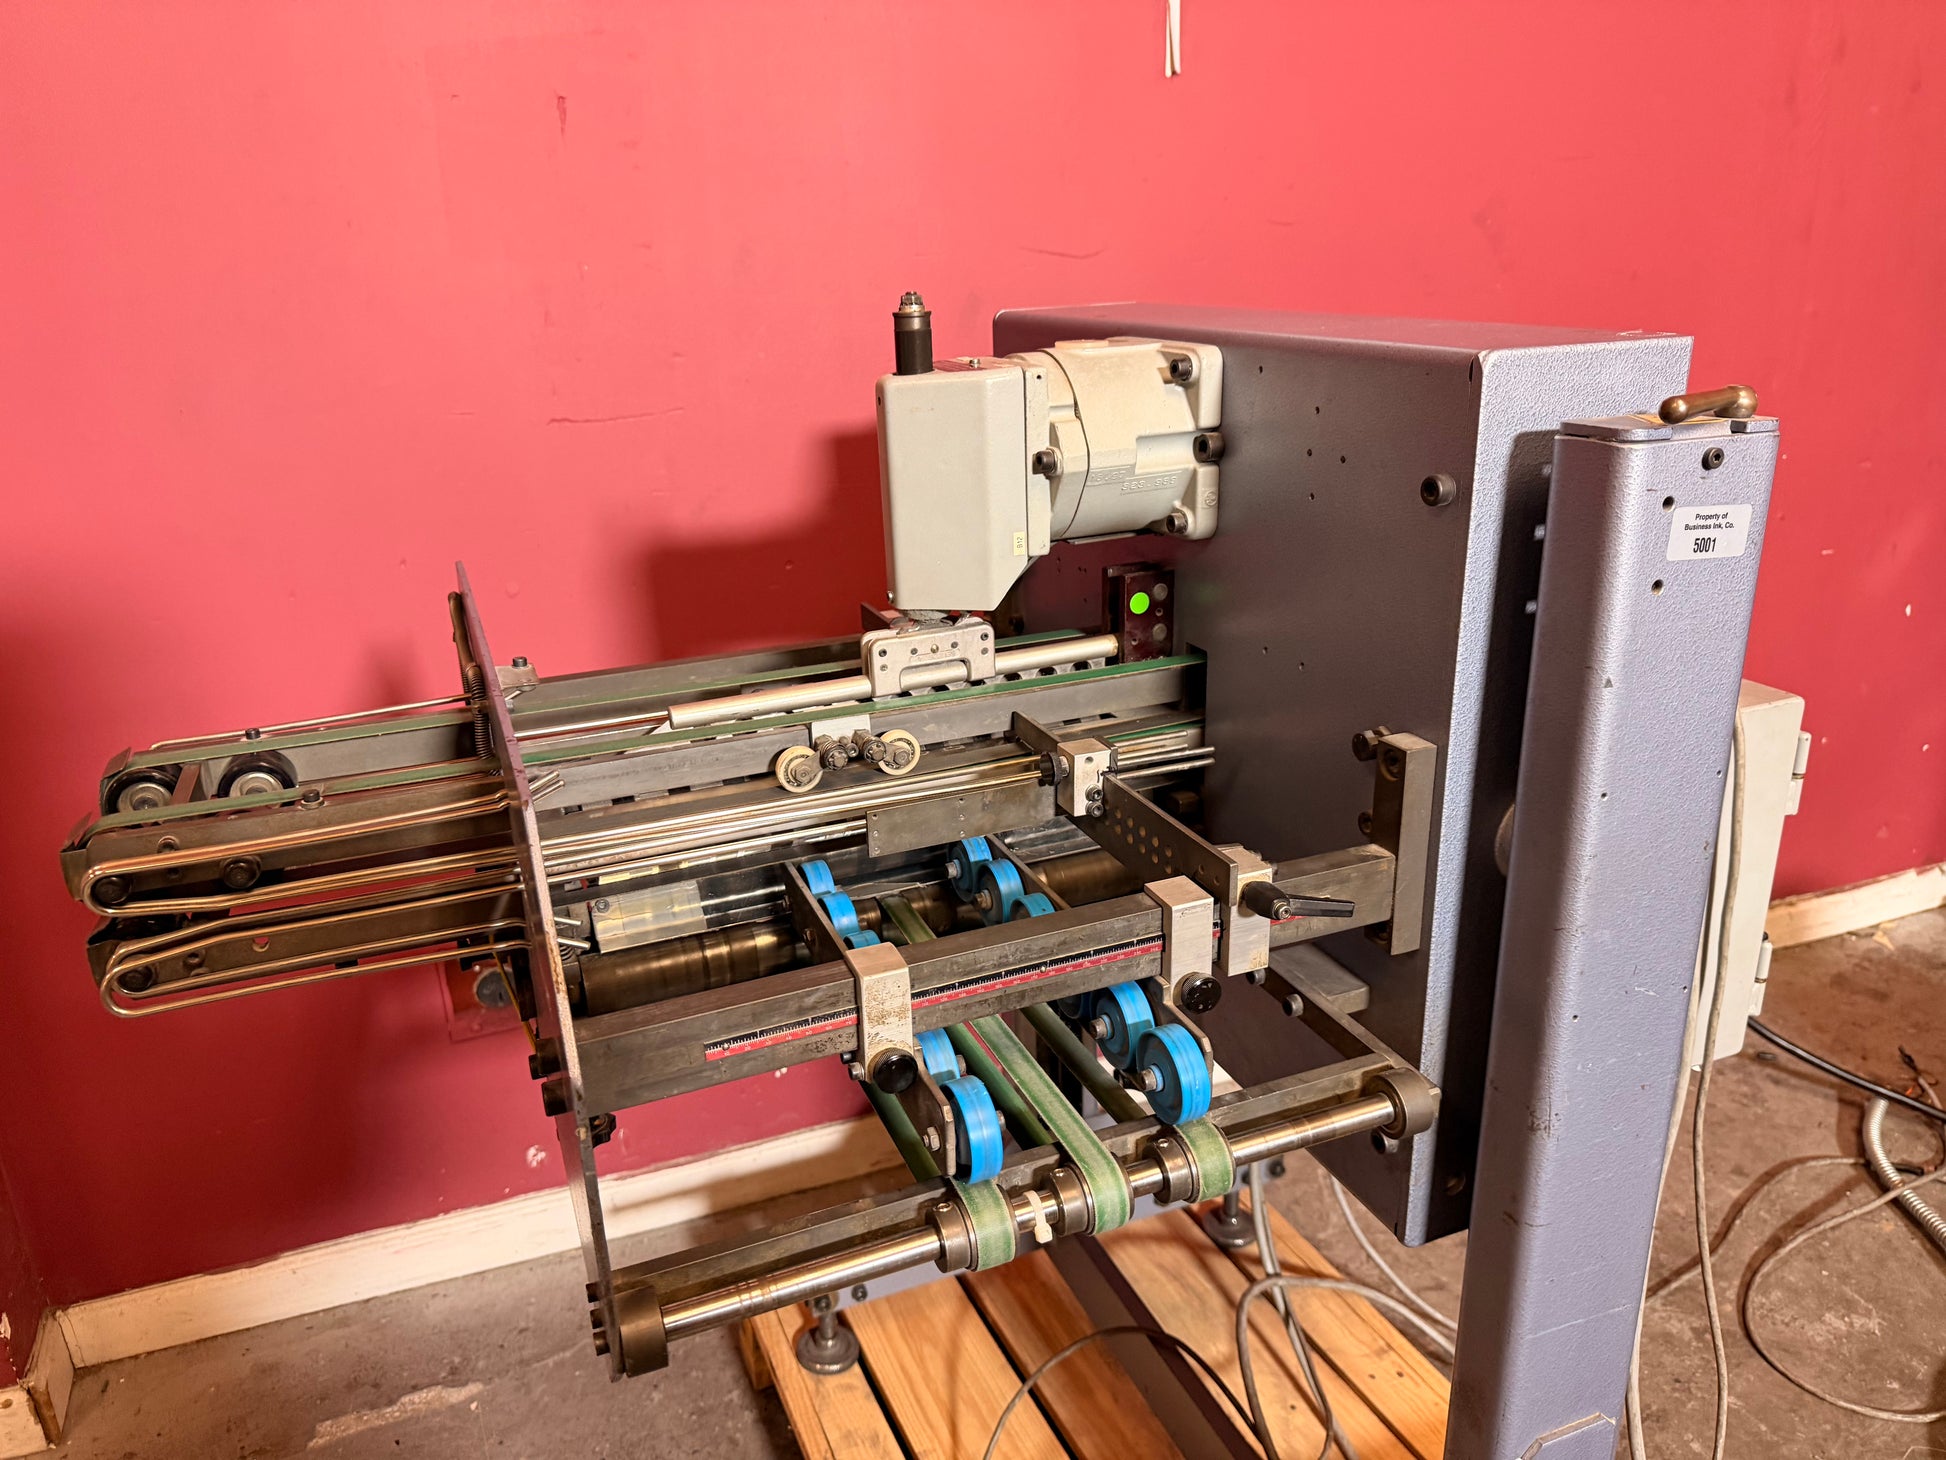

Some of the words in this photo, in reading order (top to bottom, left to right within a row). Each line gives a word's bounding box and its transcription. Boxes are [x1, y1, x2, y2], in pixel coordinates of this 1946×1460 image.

[1695, 513, 1720, 521] Property
[1713, 522, 1723, 530] Ink,
[1724, 521, 1734, 529] Co.
[1693, 537, 1717, 553] 5001
